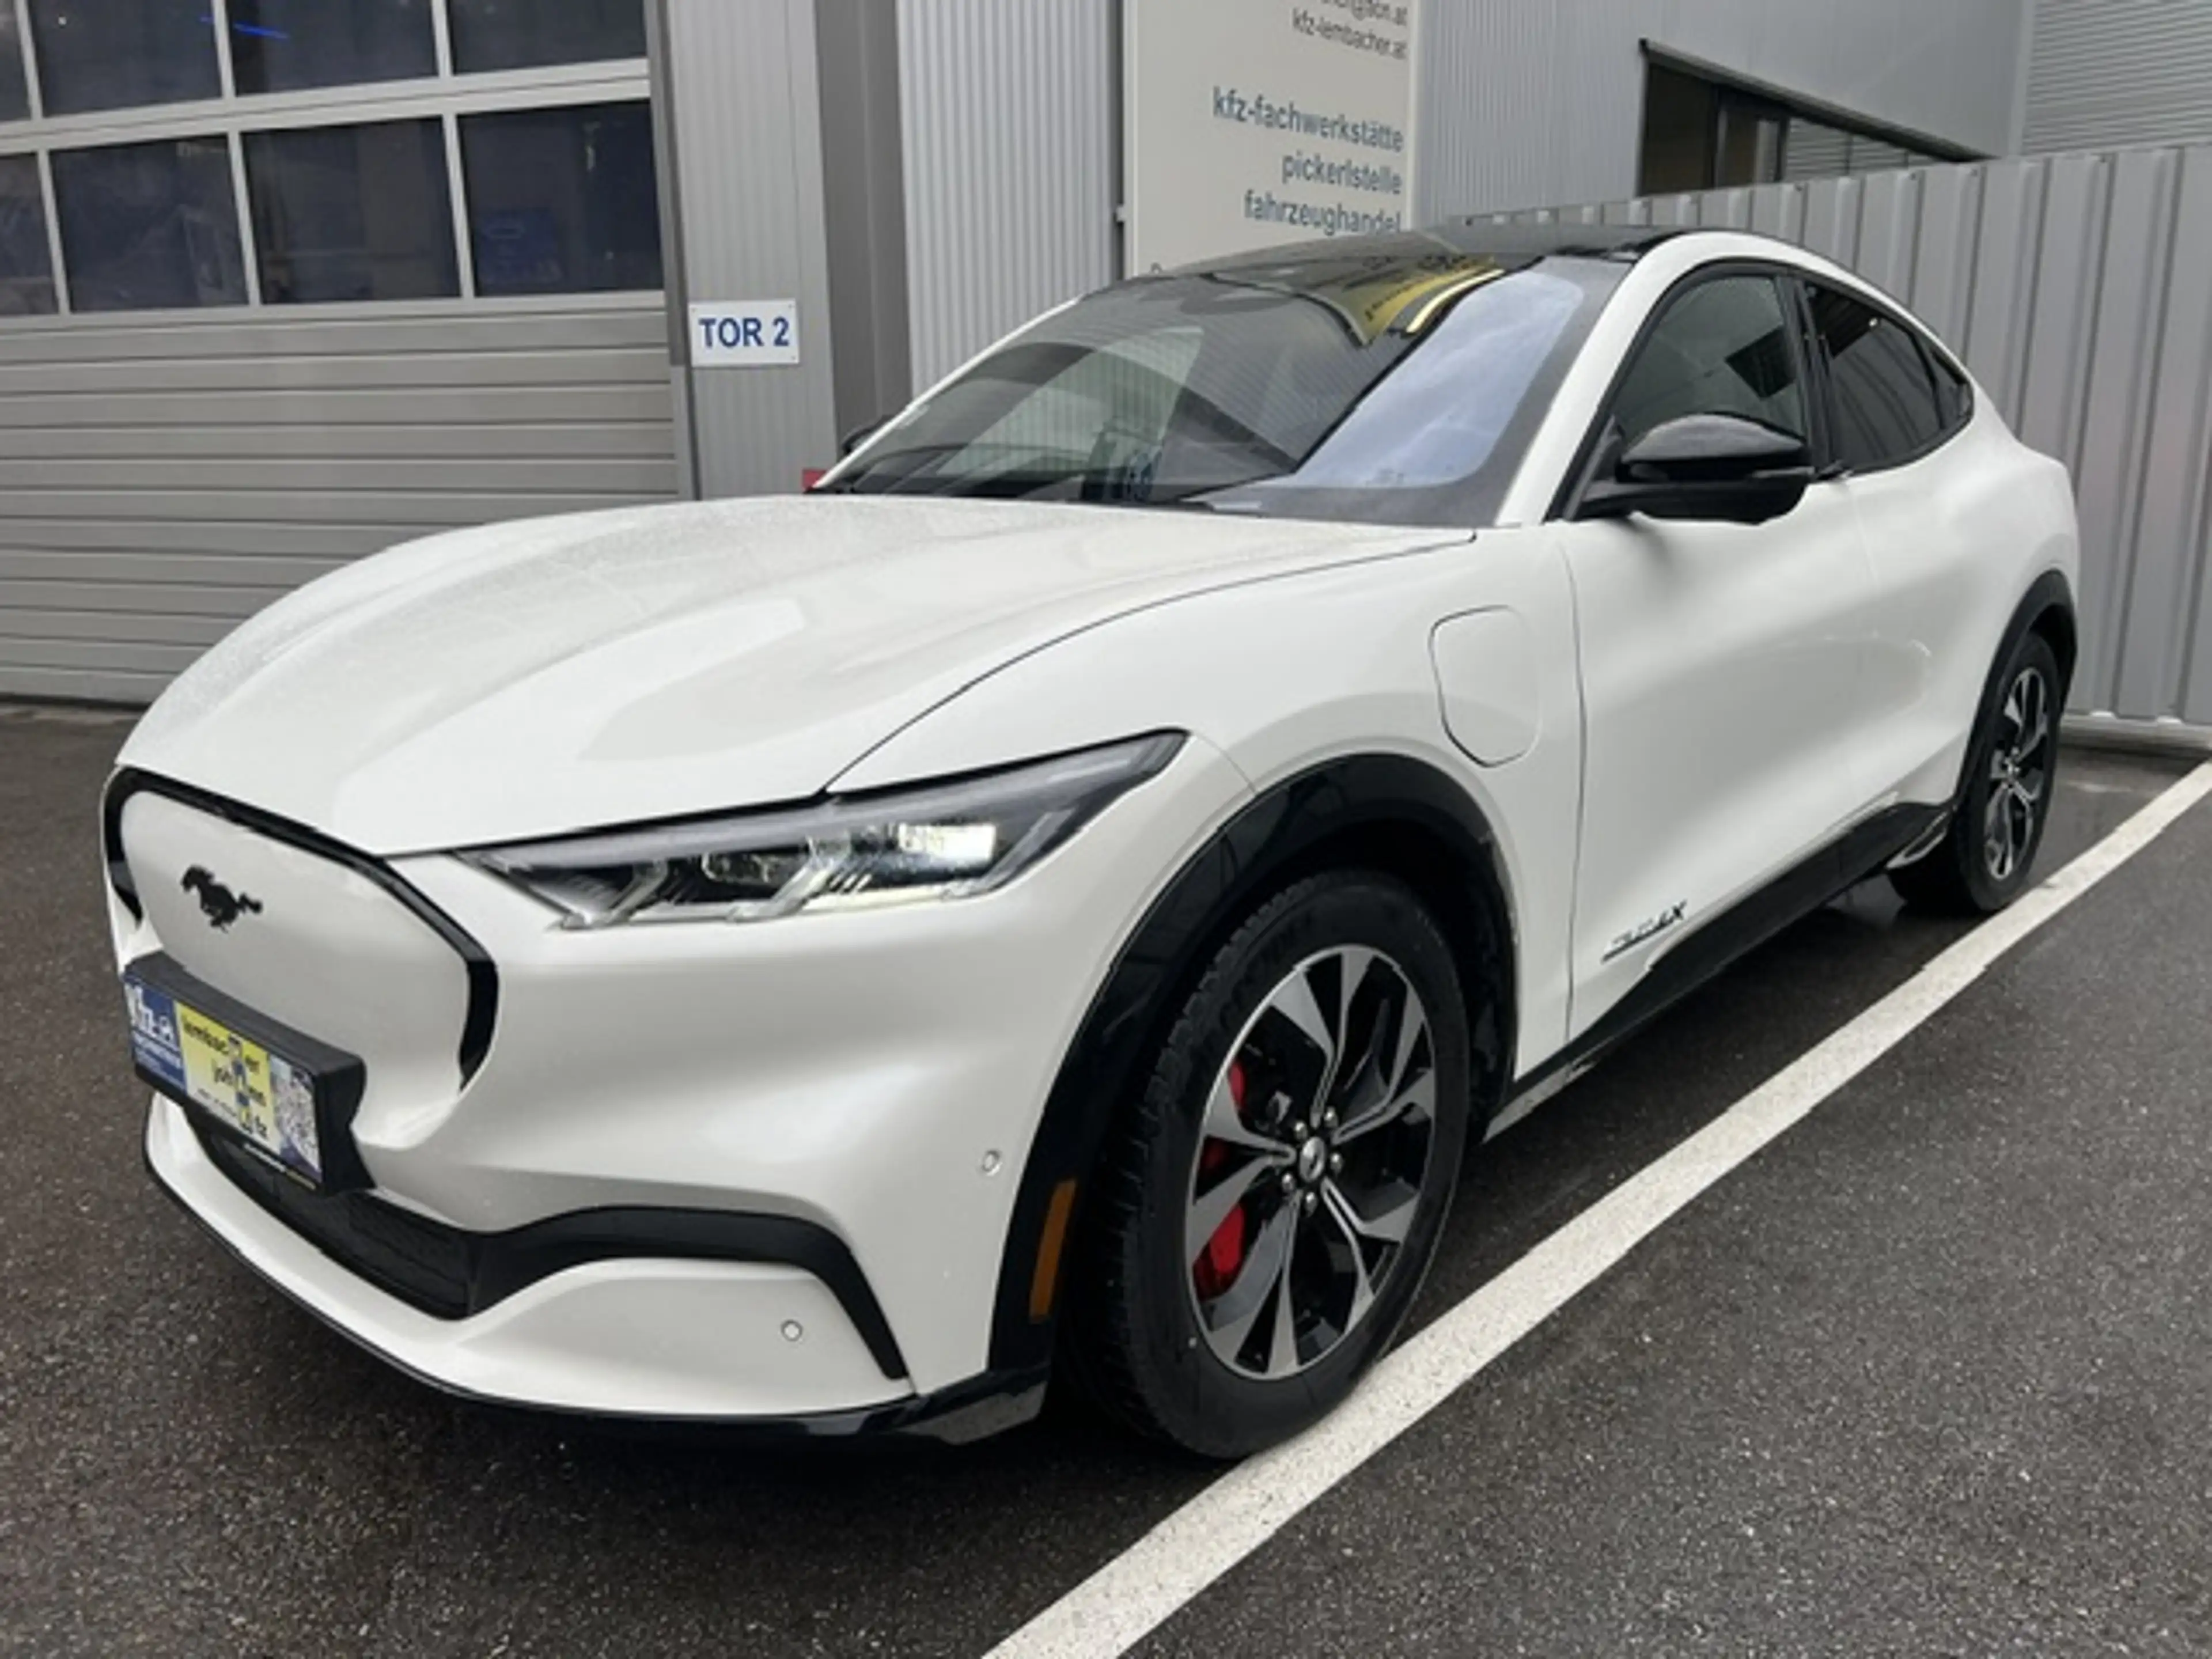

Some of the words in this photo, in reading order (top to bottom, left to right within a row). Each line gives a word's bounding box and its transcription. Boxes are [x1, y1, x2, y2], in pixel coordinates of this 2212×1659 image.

[1213, 86, 1404, 153] kfz-fachwerkstätte
[1244, 190, 1401, 236] fahrzeughandel
[698, 317, 764, 349] TOR
[773, 316, 789, 347] 2
